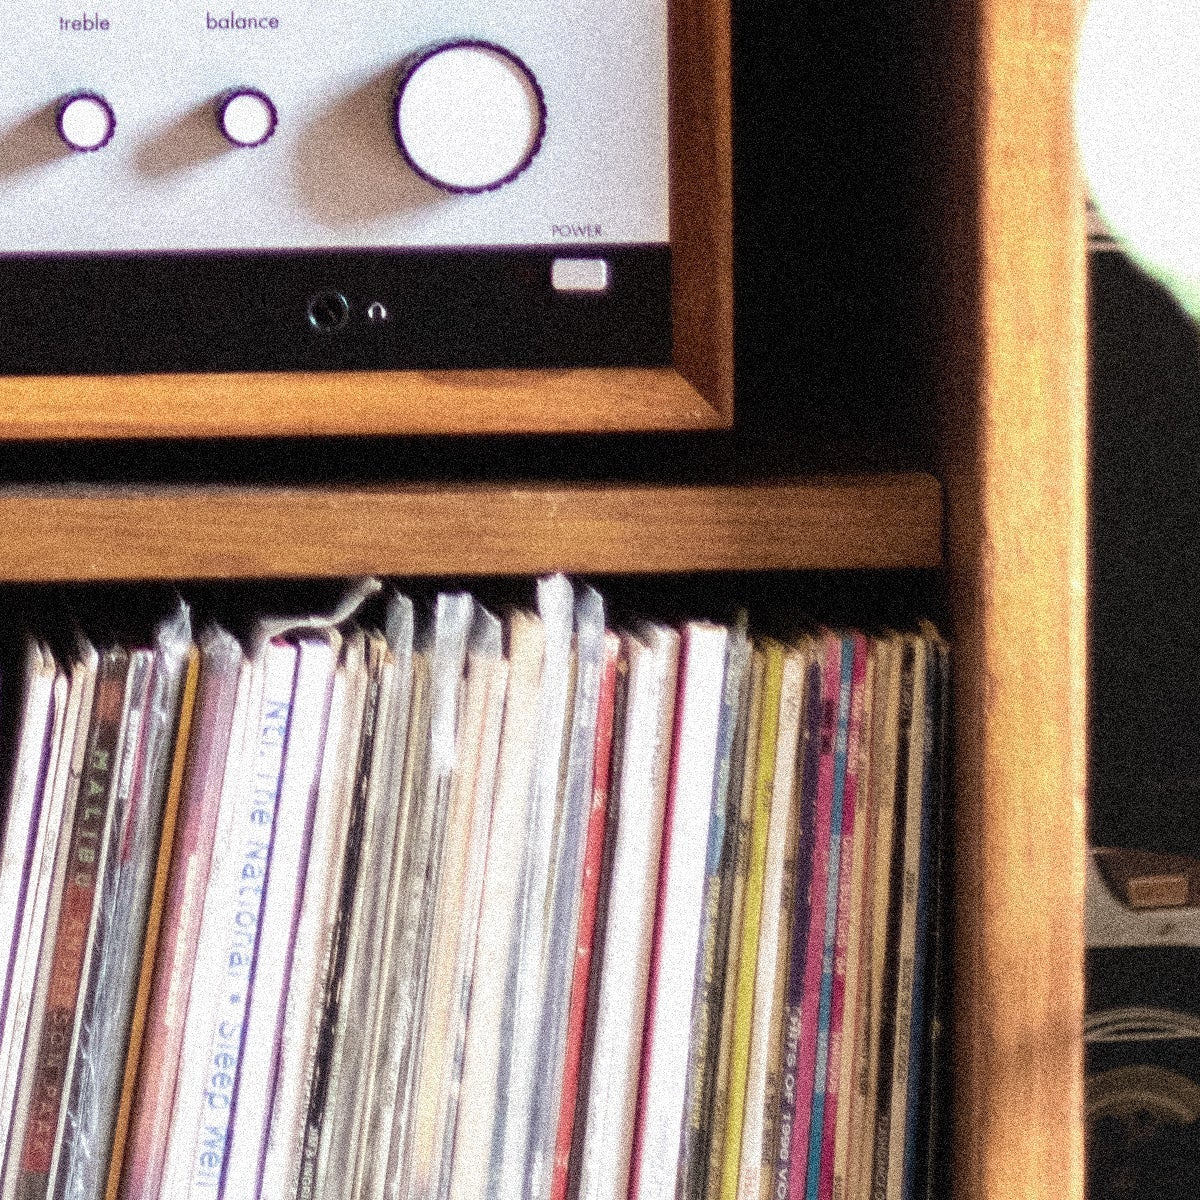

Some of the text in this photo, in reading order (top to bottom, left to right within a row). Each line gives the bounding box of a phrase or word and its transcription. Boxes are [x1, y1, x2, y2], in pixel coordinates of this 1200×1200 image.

[59, 13, 111, 32] treble
[206, 11, 280, 31] balance
[552, 224, 602, 237] POWER
[73, 748, 109, 888] MALIBU
[200, 1019, 242, 1110] Sleep
[781, 1073, 795, 1105] OF
